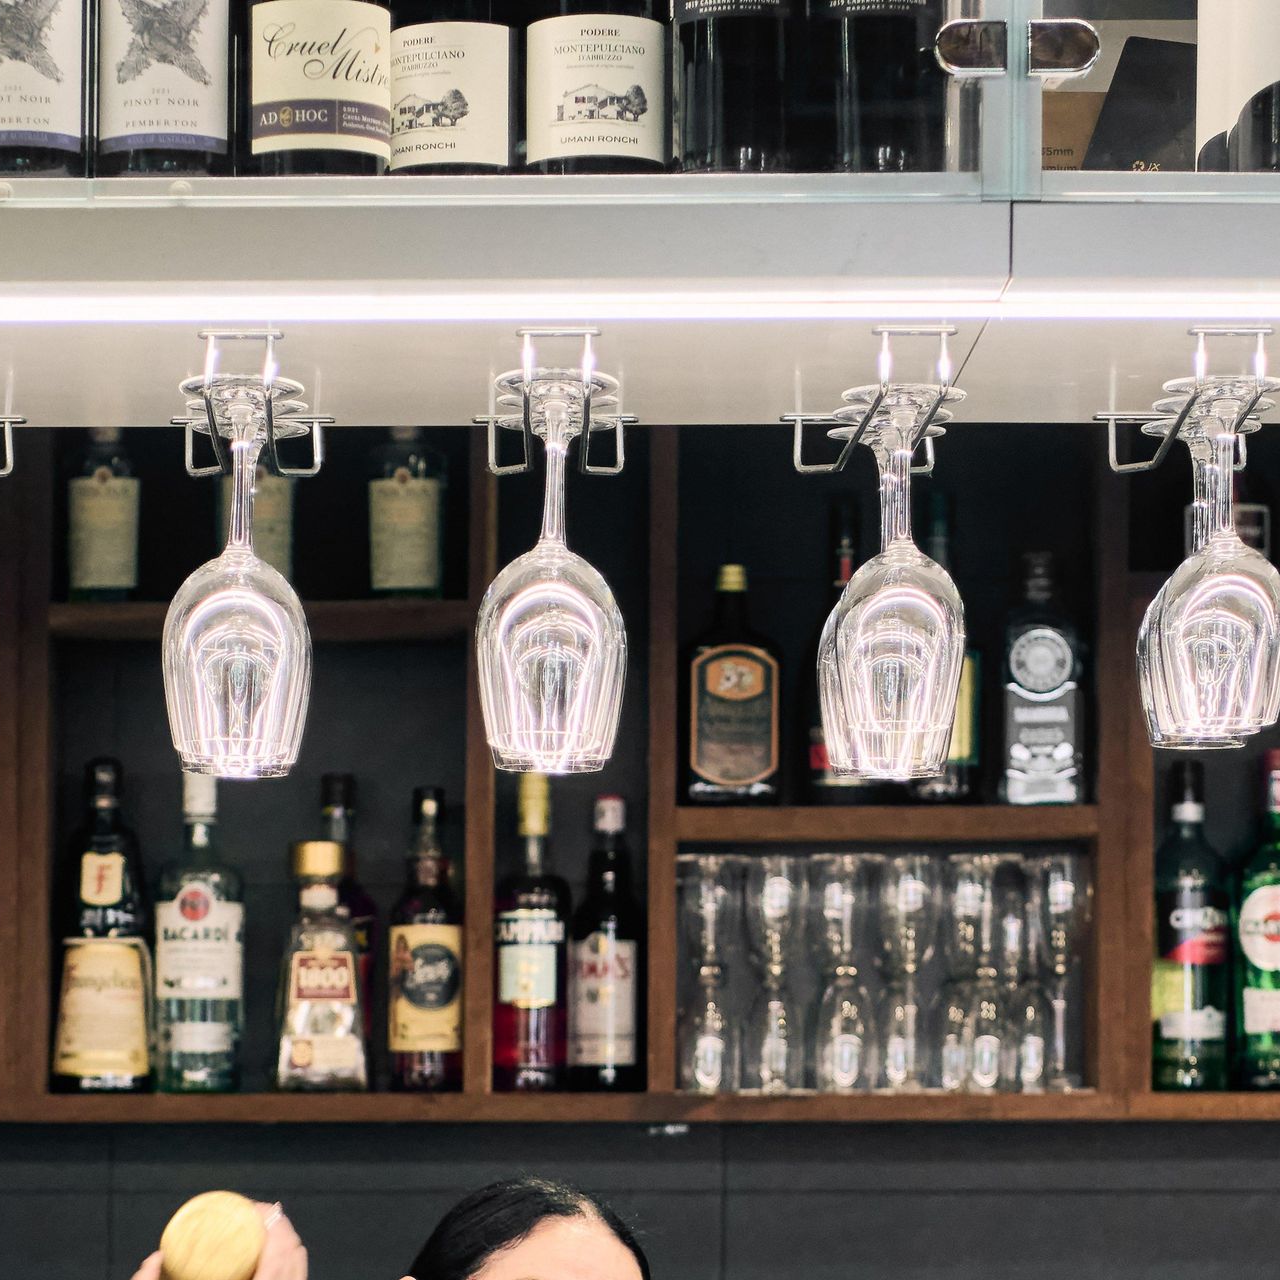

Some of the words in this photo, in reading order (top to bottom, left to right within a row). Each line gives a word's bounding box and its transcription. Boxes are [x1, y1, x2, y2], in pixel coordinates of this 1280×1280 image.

[580, 29, 620, 37] PODERE
[263, 22, 348, 60] Cruel
[403, 36, 437, 47] PODERE
[554, 45, 646, 56] MONTEPULCIANO
[20, 95, 51, 104] NOIR
[123, 98, 160, 107] PINOT
[167, 97, 200, 107] NOIR
[259, 112, 278, 126] AD
[295, 109, 329, 122] HOC
[125, 119, 198, 128] PEMBERTON
[561, 137, 595, 145] UMANI
[597, 136, 639, 144] RONCHI
[415, 142, 456, 151] RONCHI
